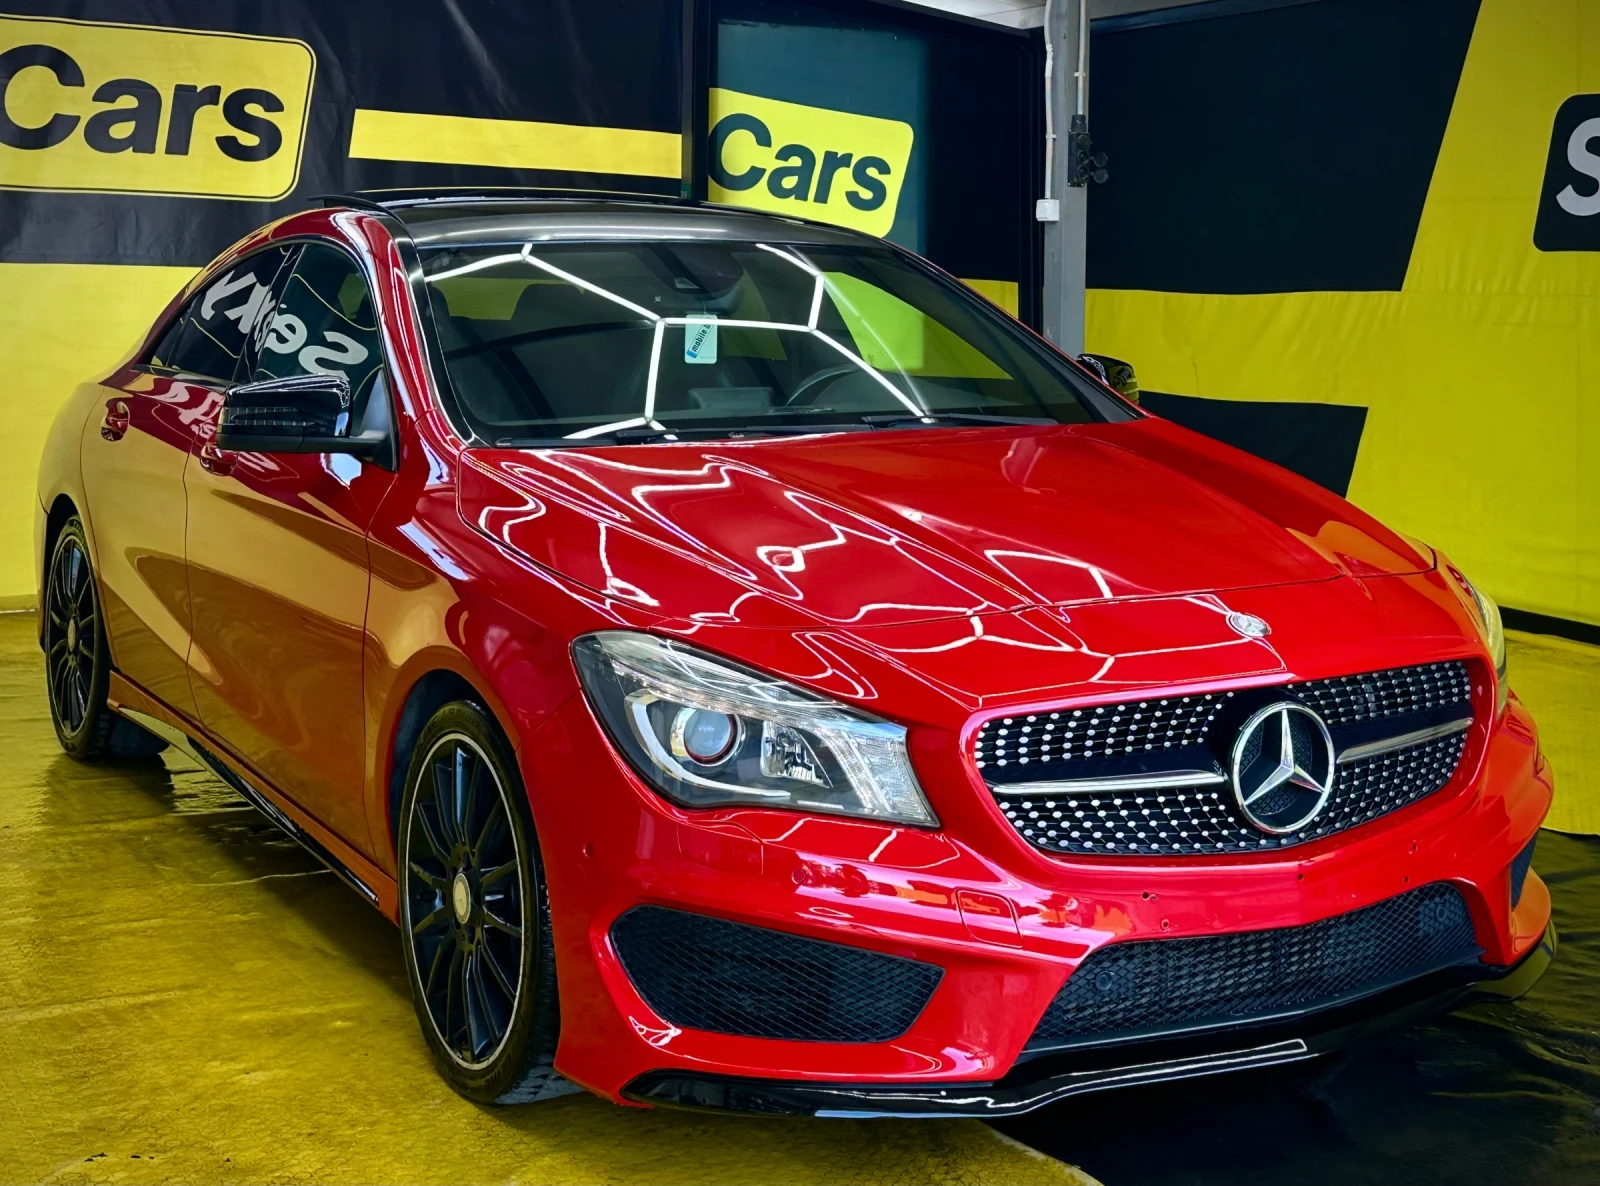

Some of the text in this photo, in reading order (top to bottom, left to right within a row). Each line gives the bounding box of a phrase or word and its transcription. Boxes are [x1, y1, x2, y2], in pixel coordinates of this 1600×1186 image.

[0, 43, 285, 162] Cars
[708, 113, 892, 212] Cars
[691, 329, 708, 353] mobile
